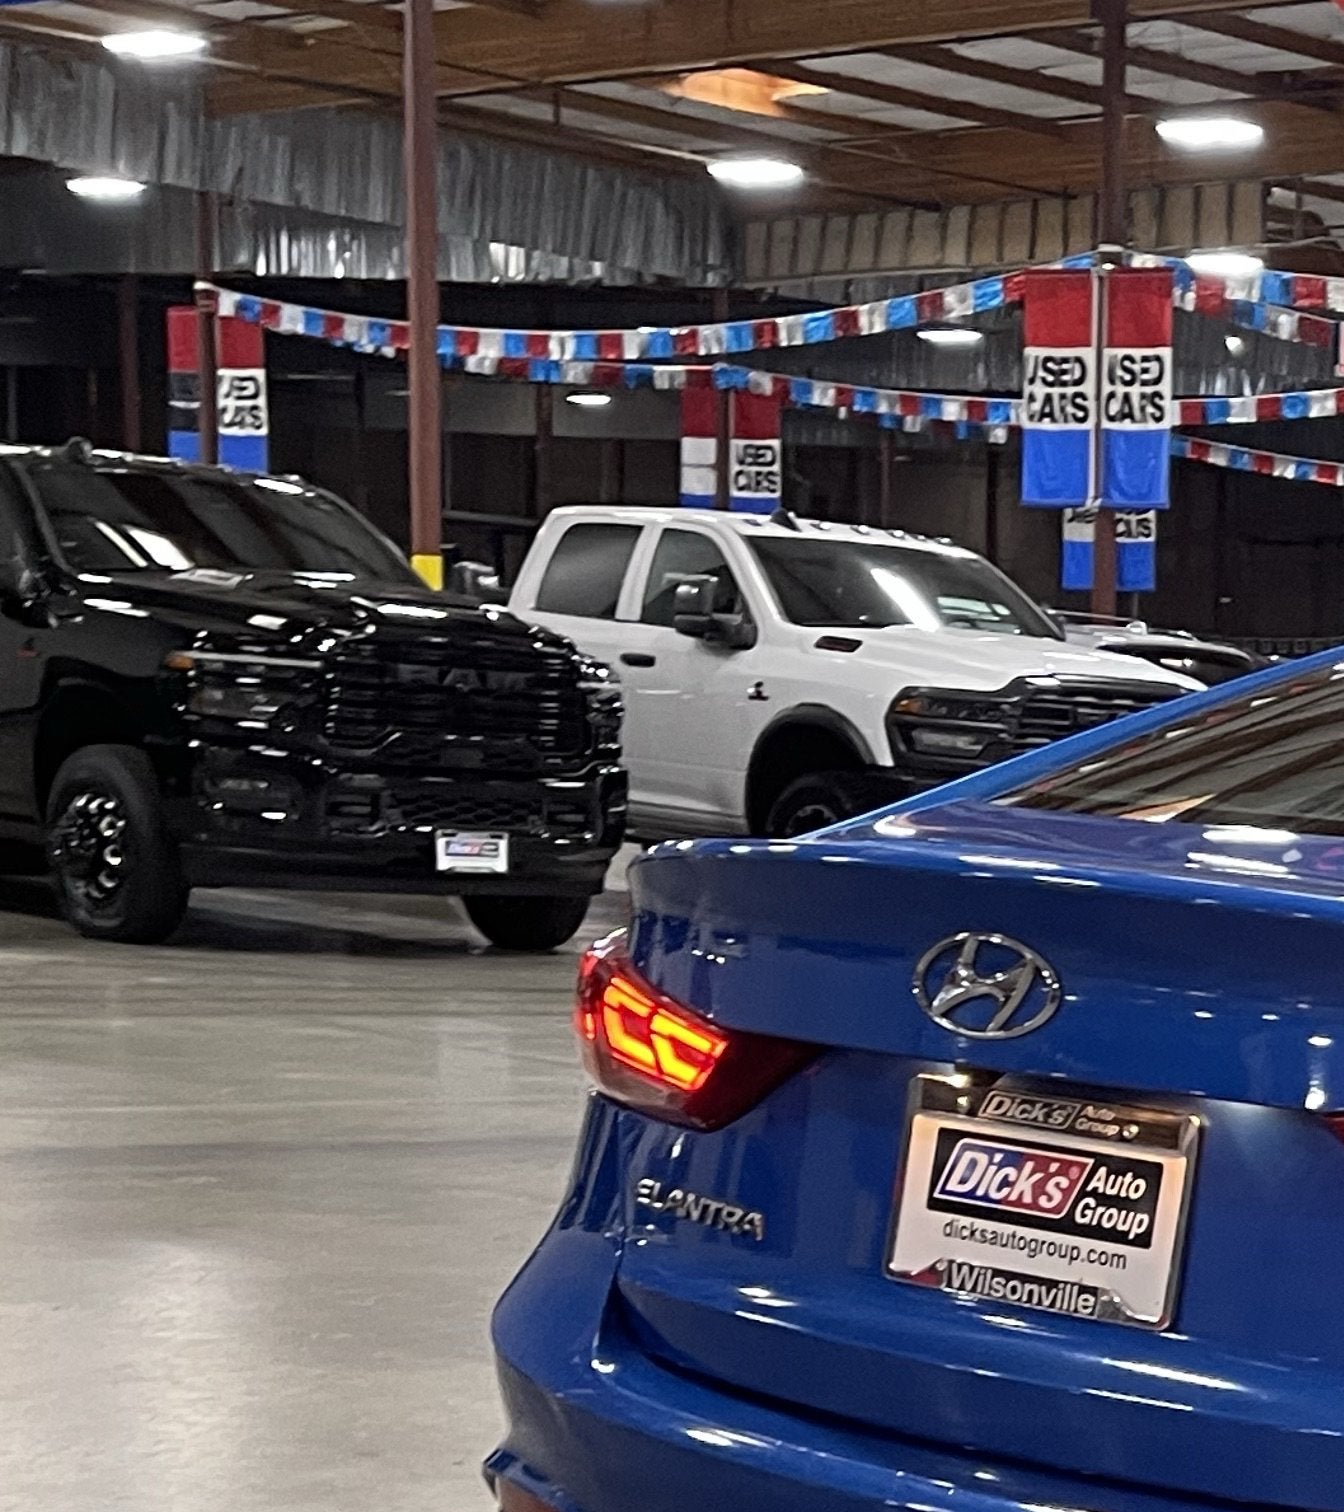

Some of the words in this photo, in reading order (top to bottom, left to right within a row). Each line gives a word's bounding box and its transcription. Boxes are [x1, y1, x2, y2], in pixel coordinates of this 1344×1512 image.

[986, 1095, 1070, 1125] Dick's
[945, 1150, 1071, 1209] Dick's
[1086, 1166, 1147, 1200] Auto
[637, 1178, 763, 1241] ELANTRA
[1074, 1197, 1150, 1240] Group
[943, 1219, 1128, 1270] dicksautogroup.com
[951, 1262, 1096, 1314] Wilsonville
